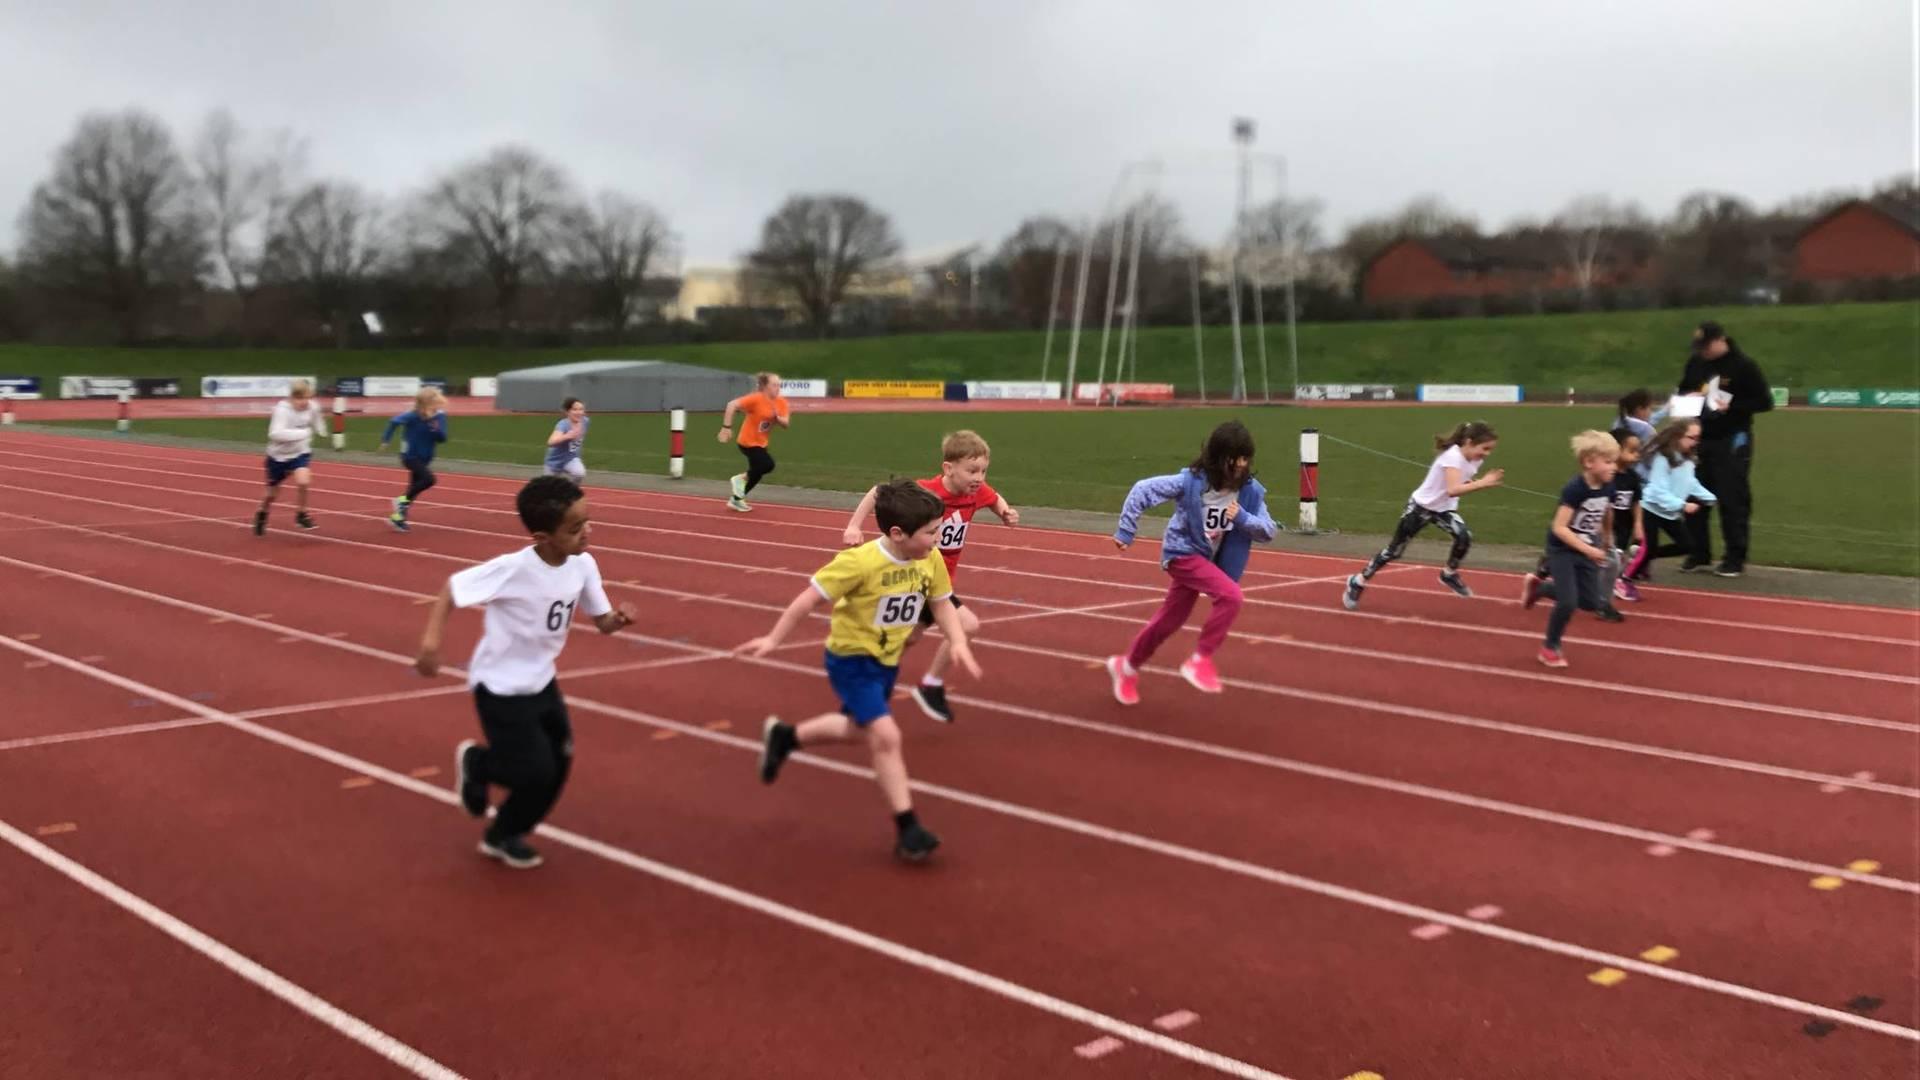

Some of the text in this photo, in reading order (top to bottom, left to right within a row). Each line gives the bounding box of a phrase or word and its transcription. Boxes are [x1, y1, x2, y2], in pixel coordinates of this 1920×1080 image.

[940, 525, 966, 546] 64
[546, 599, 575, 631] 61
[882, 595, 917, 623] 56
